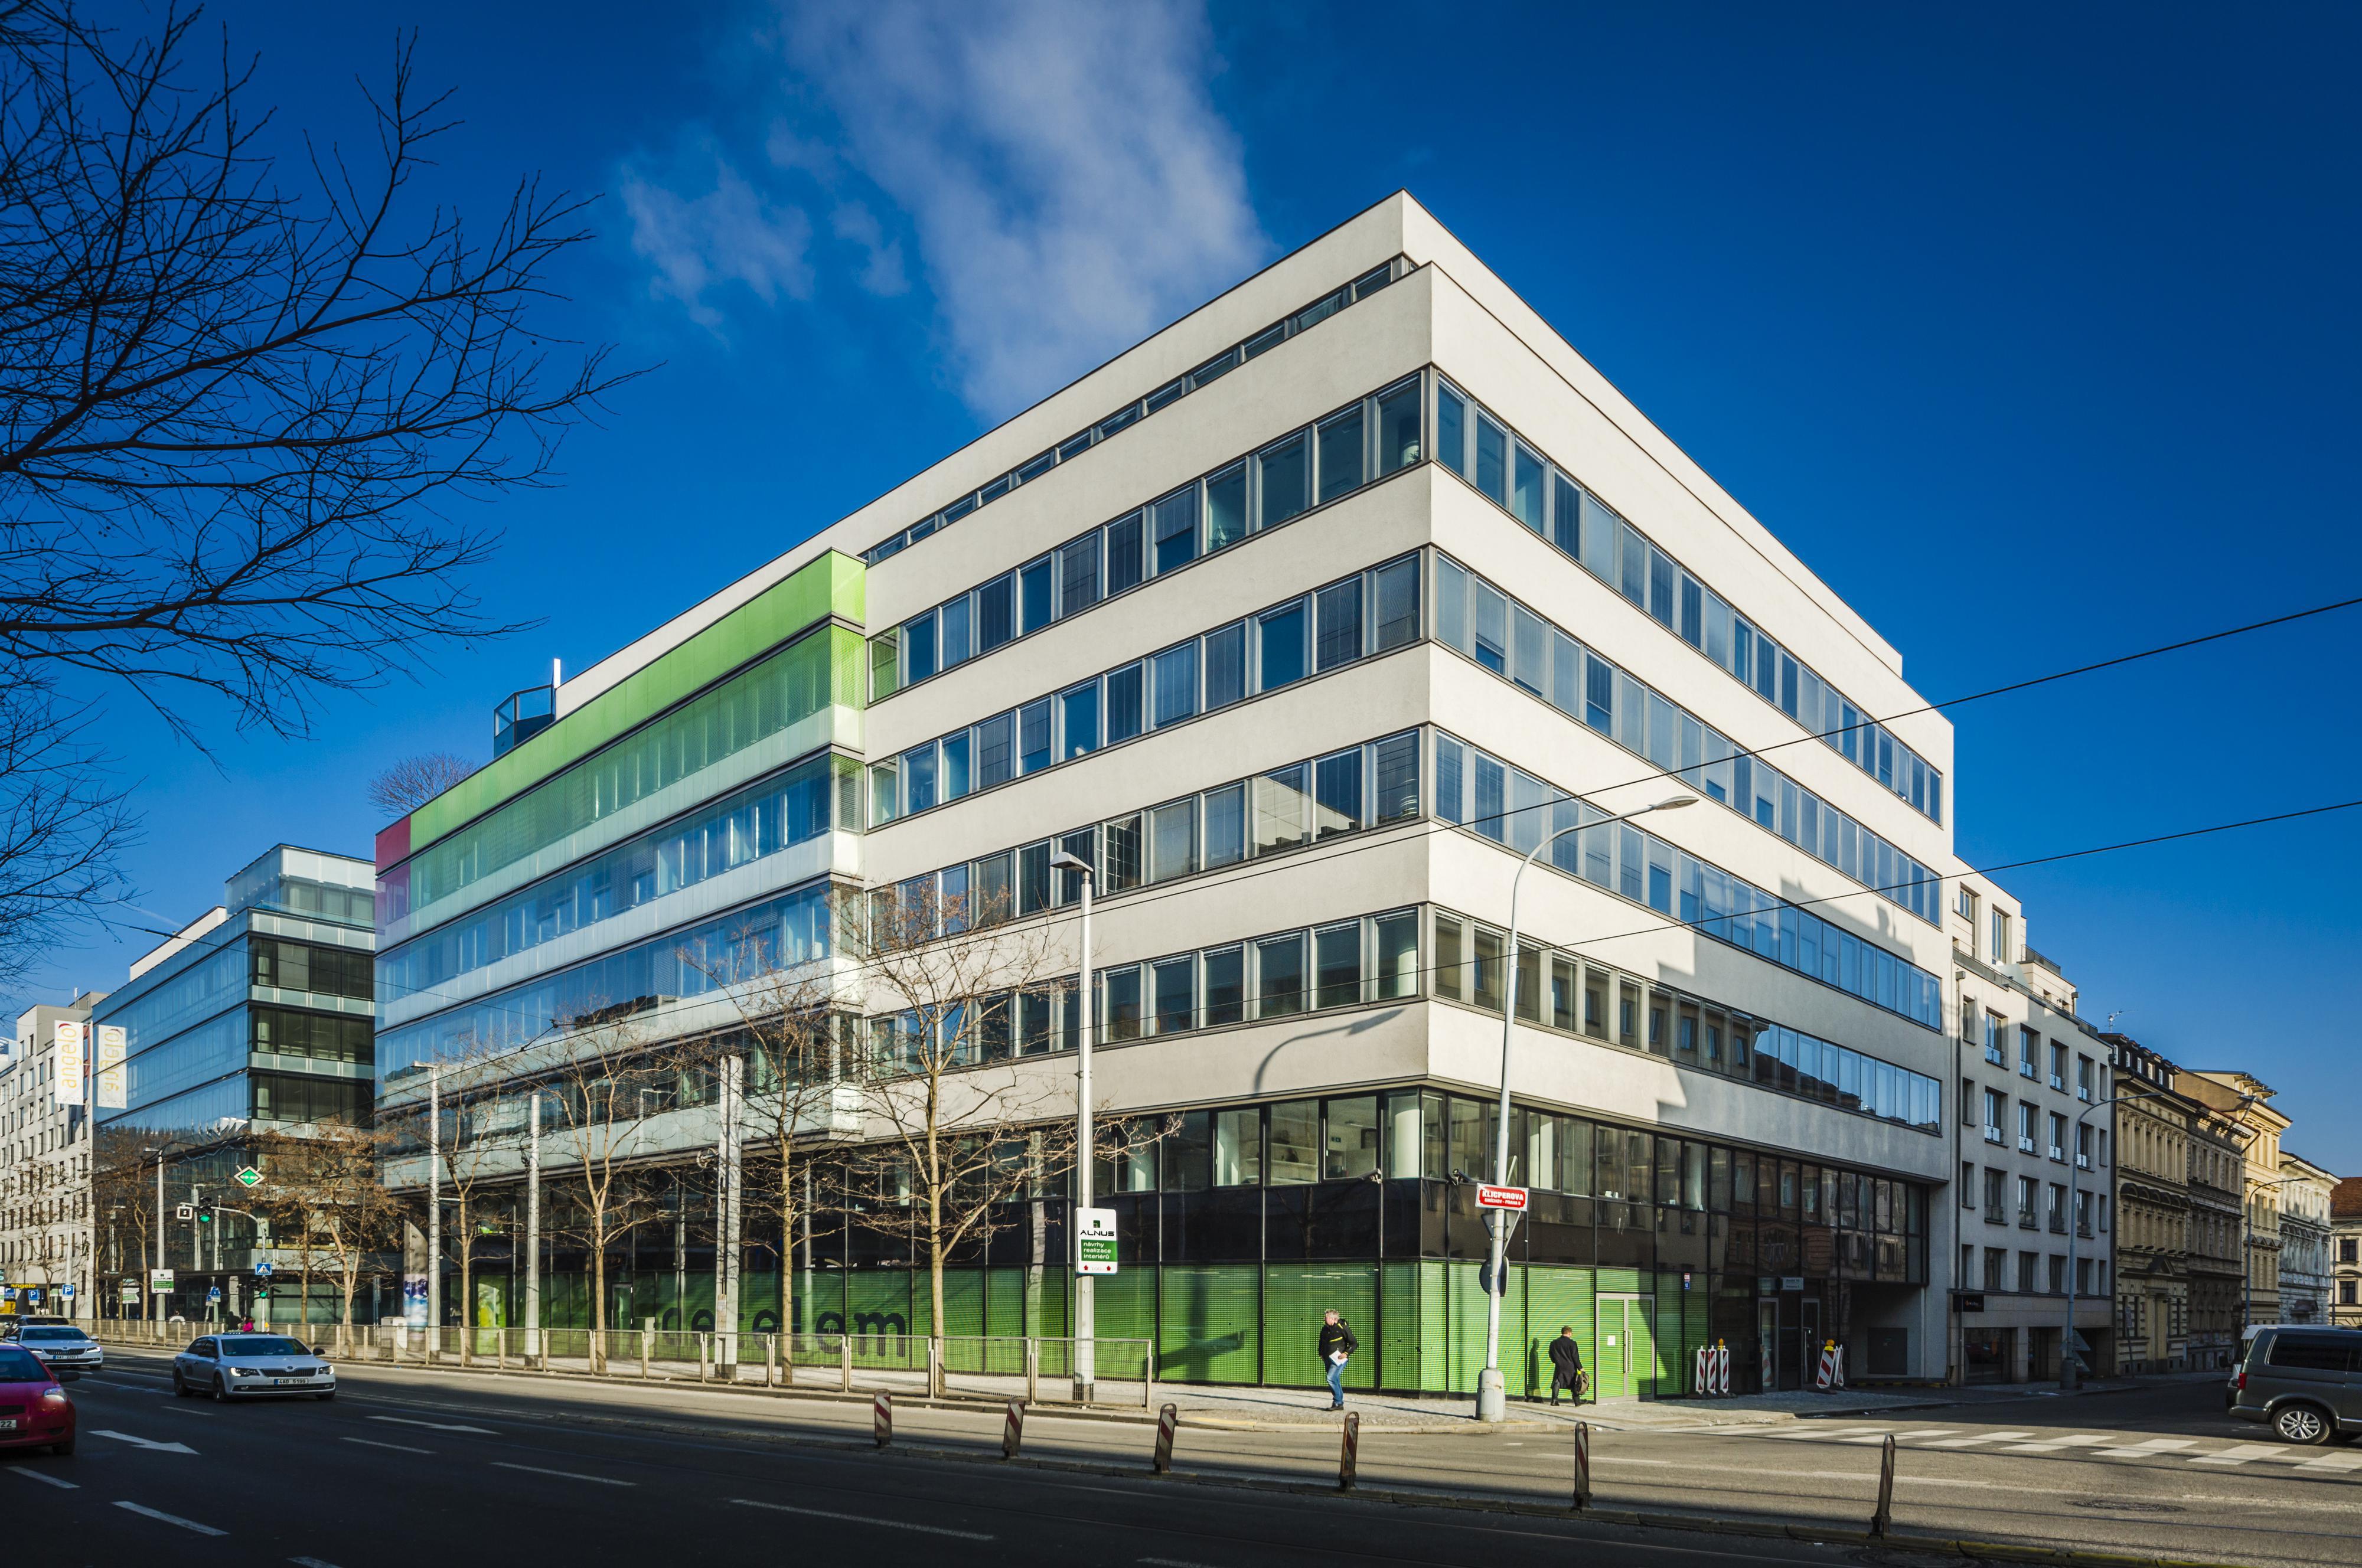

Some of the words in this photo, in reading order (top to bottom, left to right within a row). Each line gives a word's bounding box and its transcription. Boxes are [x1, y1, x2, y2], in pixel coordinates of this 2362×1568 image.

[57, 1028, 82, 1088] angelo
[1482, 1190, 1523, 1200] KLICPEROVA
[662, 1296, 906, 1357] ceelem
